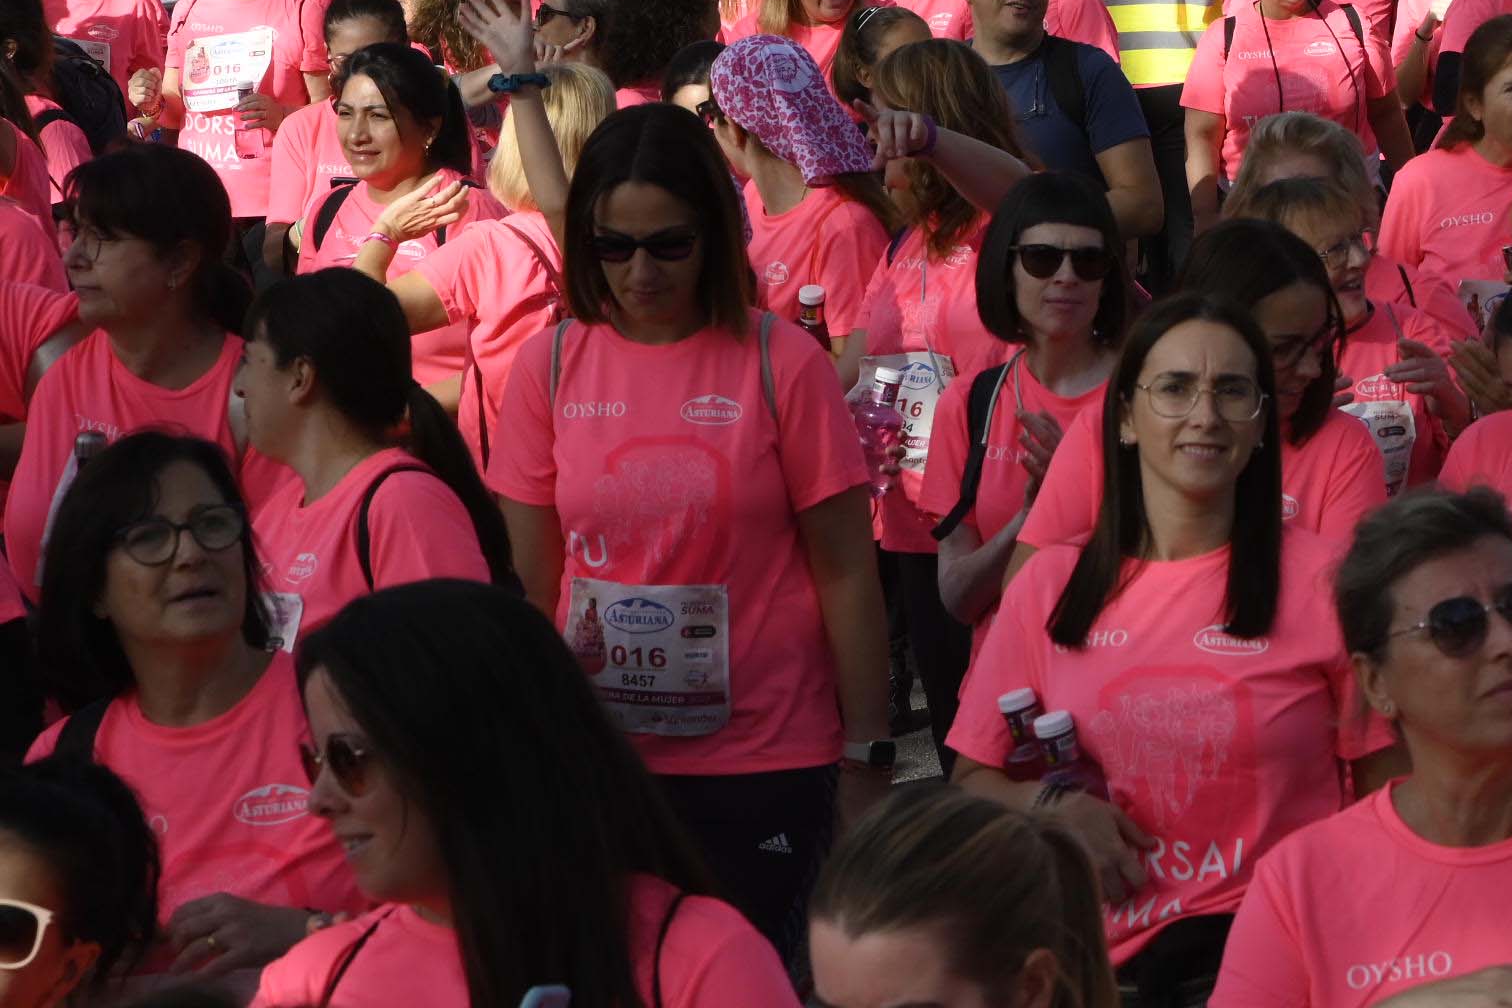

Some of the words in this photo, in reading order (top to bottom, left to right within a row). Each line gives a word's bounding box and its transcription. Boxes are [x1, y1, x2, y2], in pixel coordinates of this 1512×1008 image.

[1238, 50, 1276, 60] OYSHO
[185, 113, 235, 135] DORS
[1441, 212, 1494, 228] OYSHO
[563, 401, 625, 418] OYSHO
[687, 405, 738, 418] ASTURIANA
[897, 398, 923, 417] 16
[611, 608, 668, 625] ASTURIANA
[681, 605, 714, 616] SUMA
[1200, 632, 1264, 648] ASTURIANA
[611, 644, 667, 667] 016
[621, 674, 656, 687] 8457
[1347, 950, 1453, 990] OYSHO
